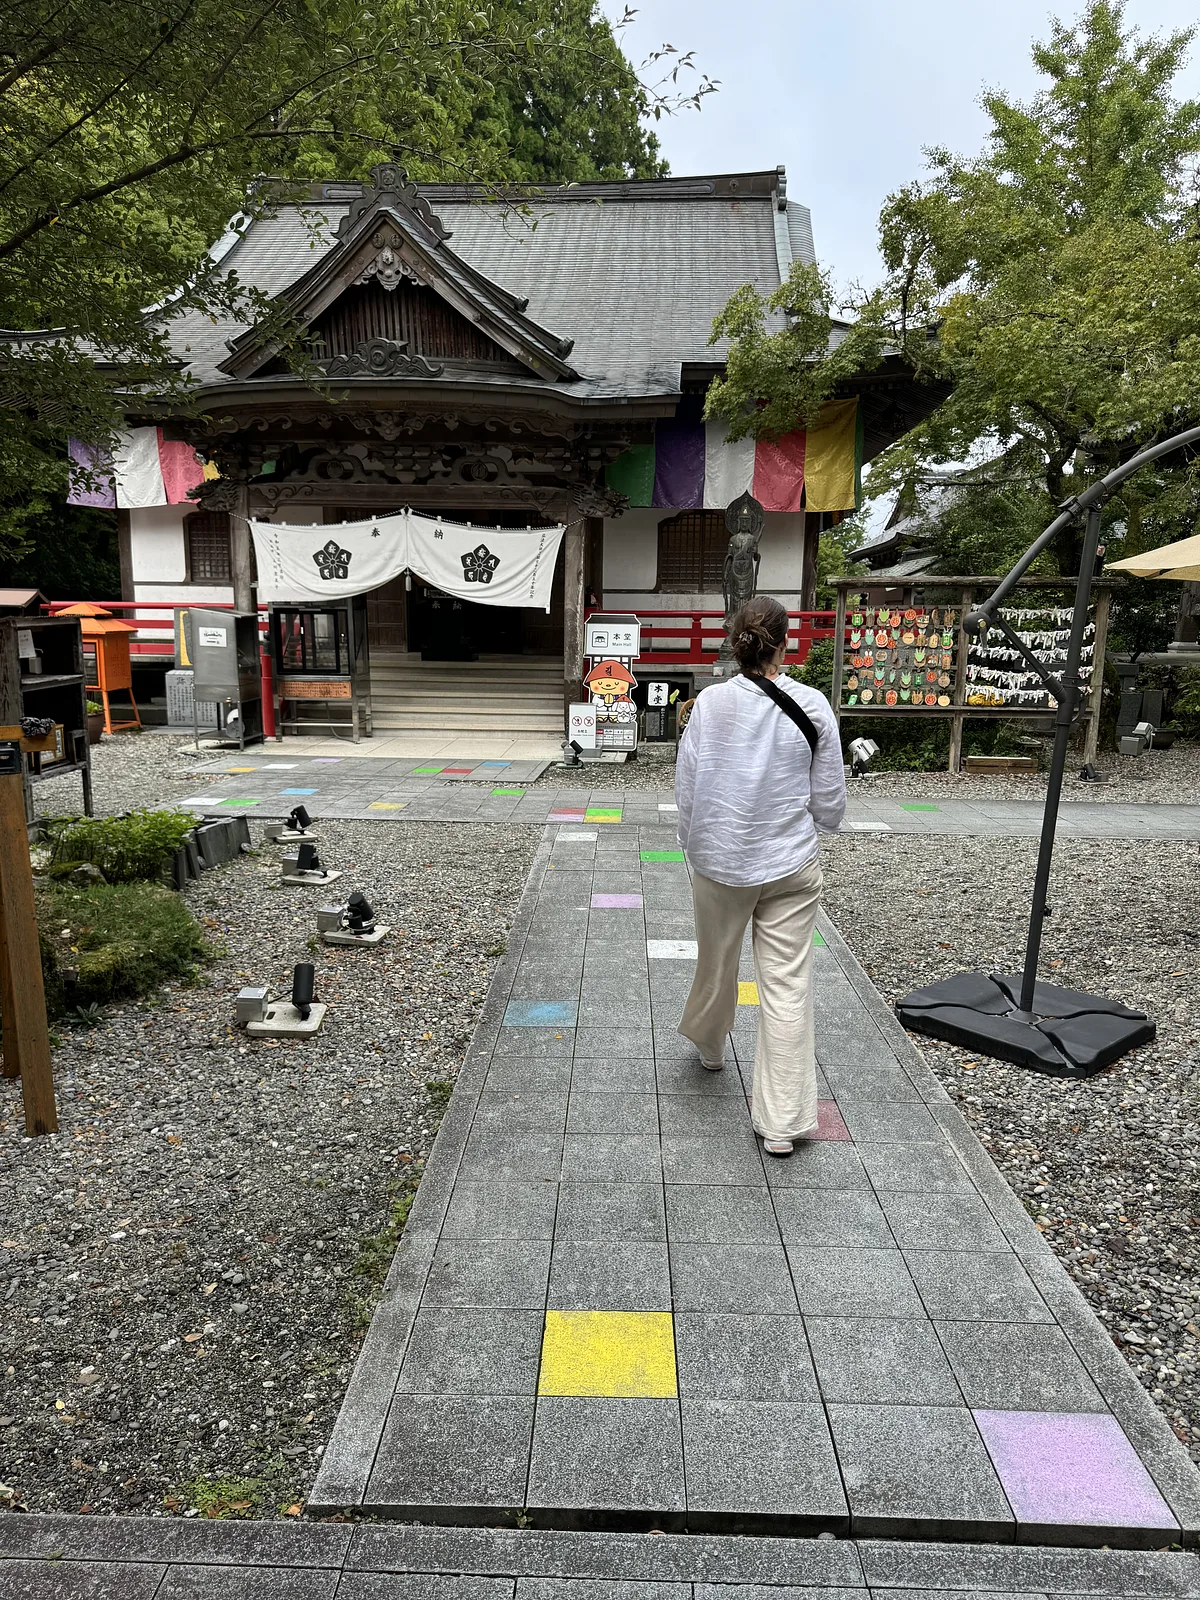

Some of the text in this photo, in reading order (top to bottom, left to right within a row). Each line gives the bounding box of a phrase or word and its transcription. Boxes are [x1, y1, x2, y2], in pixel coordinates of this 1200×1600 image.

[371, 527, 444, 540] 奉 納
[613, 632, 632, 641] 本堂
[653, 684, 663, 705] 本堂
